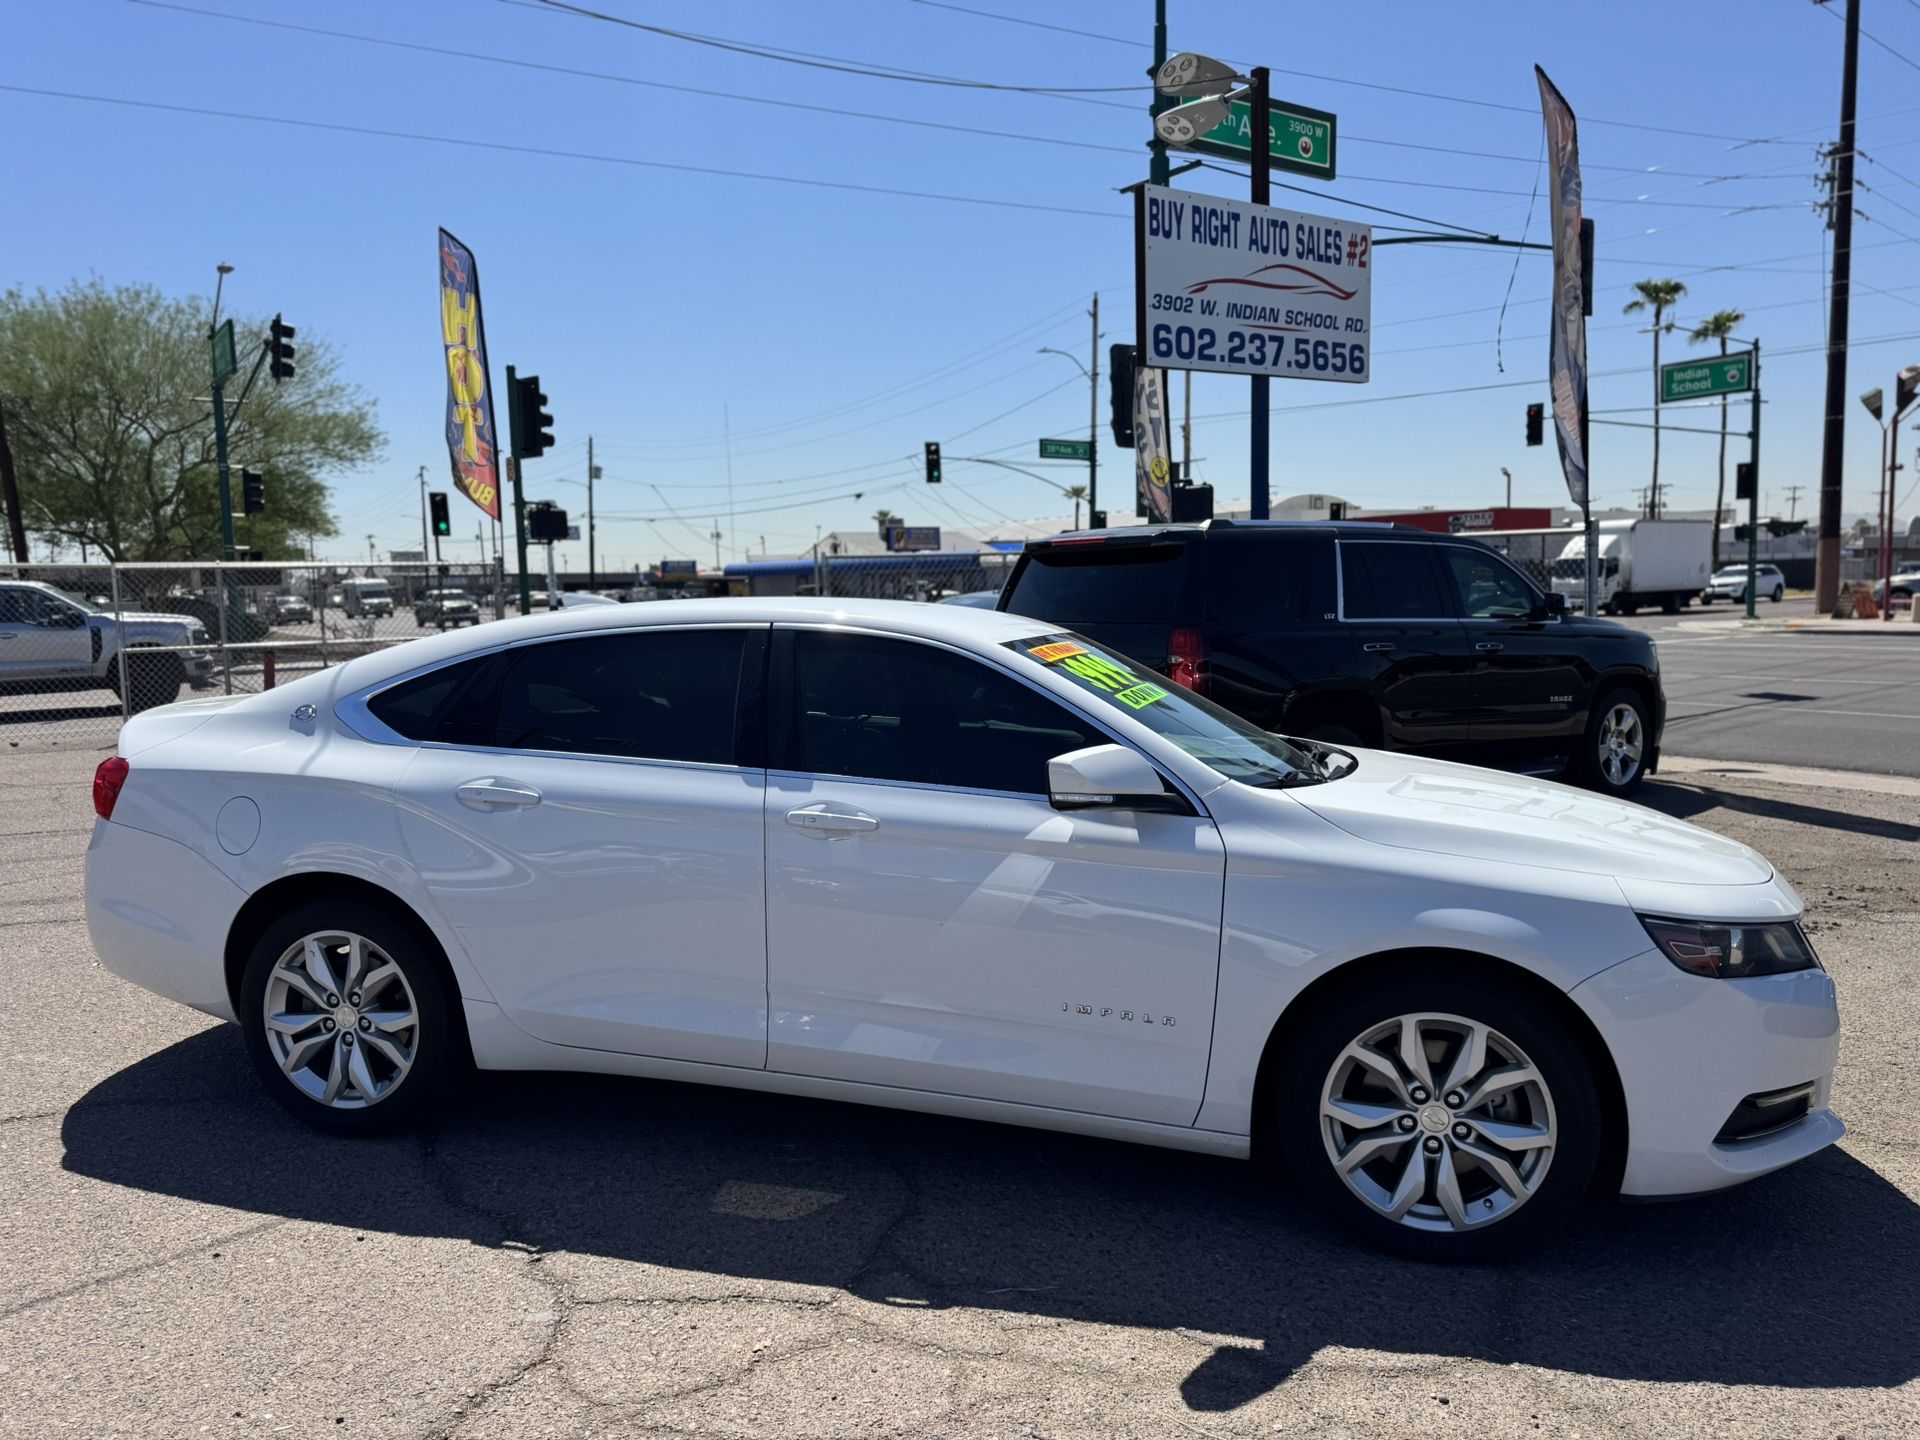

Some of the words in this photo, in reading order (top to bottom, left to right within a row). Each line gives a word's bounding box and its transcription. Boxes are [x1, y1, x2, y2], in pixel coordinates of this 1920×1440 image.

[1238, 115, 1282, 146] Ae.
[1288, 120, 1313, 136] 3900
[1315, 126, 1324, 139] W
[1149, 197, 1185, 241] BUY
[1192, 205, 1241, 249] RIGHT
[1249, 215, 1290, 257] AUTO
[1296, 223, 1342, 265] SALES
[1346, 232, 1368, 268] #2
[1152, 293, 1194, 314] 3902
[1200, 299, 1219, 317] W.
[1226, 302, 1280, 323] INDIAN
[1284, 309, 1339, 330] SCHOOL
[1344, 317, 1367, 334] RD.
[1153, 323, 1365, 375] 602.237.5656
[442, 287, 484, 463] HOT
[1671, 379, 1712, 394] School
[1673, 367, 1710, 381] Indian
[1121, 683, 1163, 705] DOWN
[1062, 1002, 1177, 1027] IMPALA
